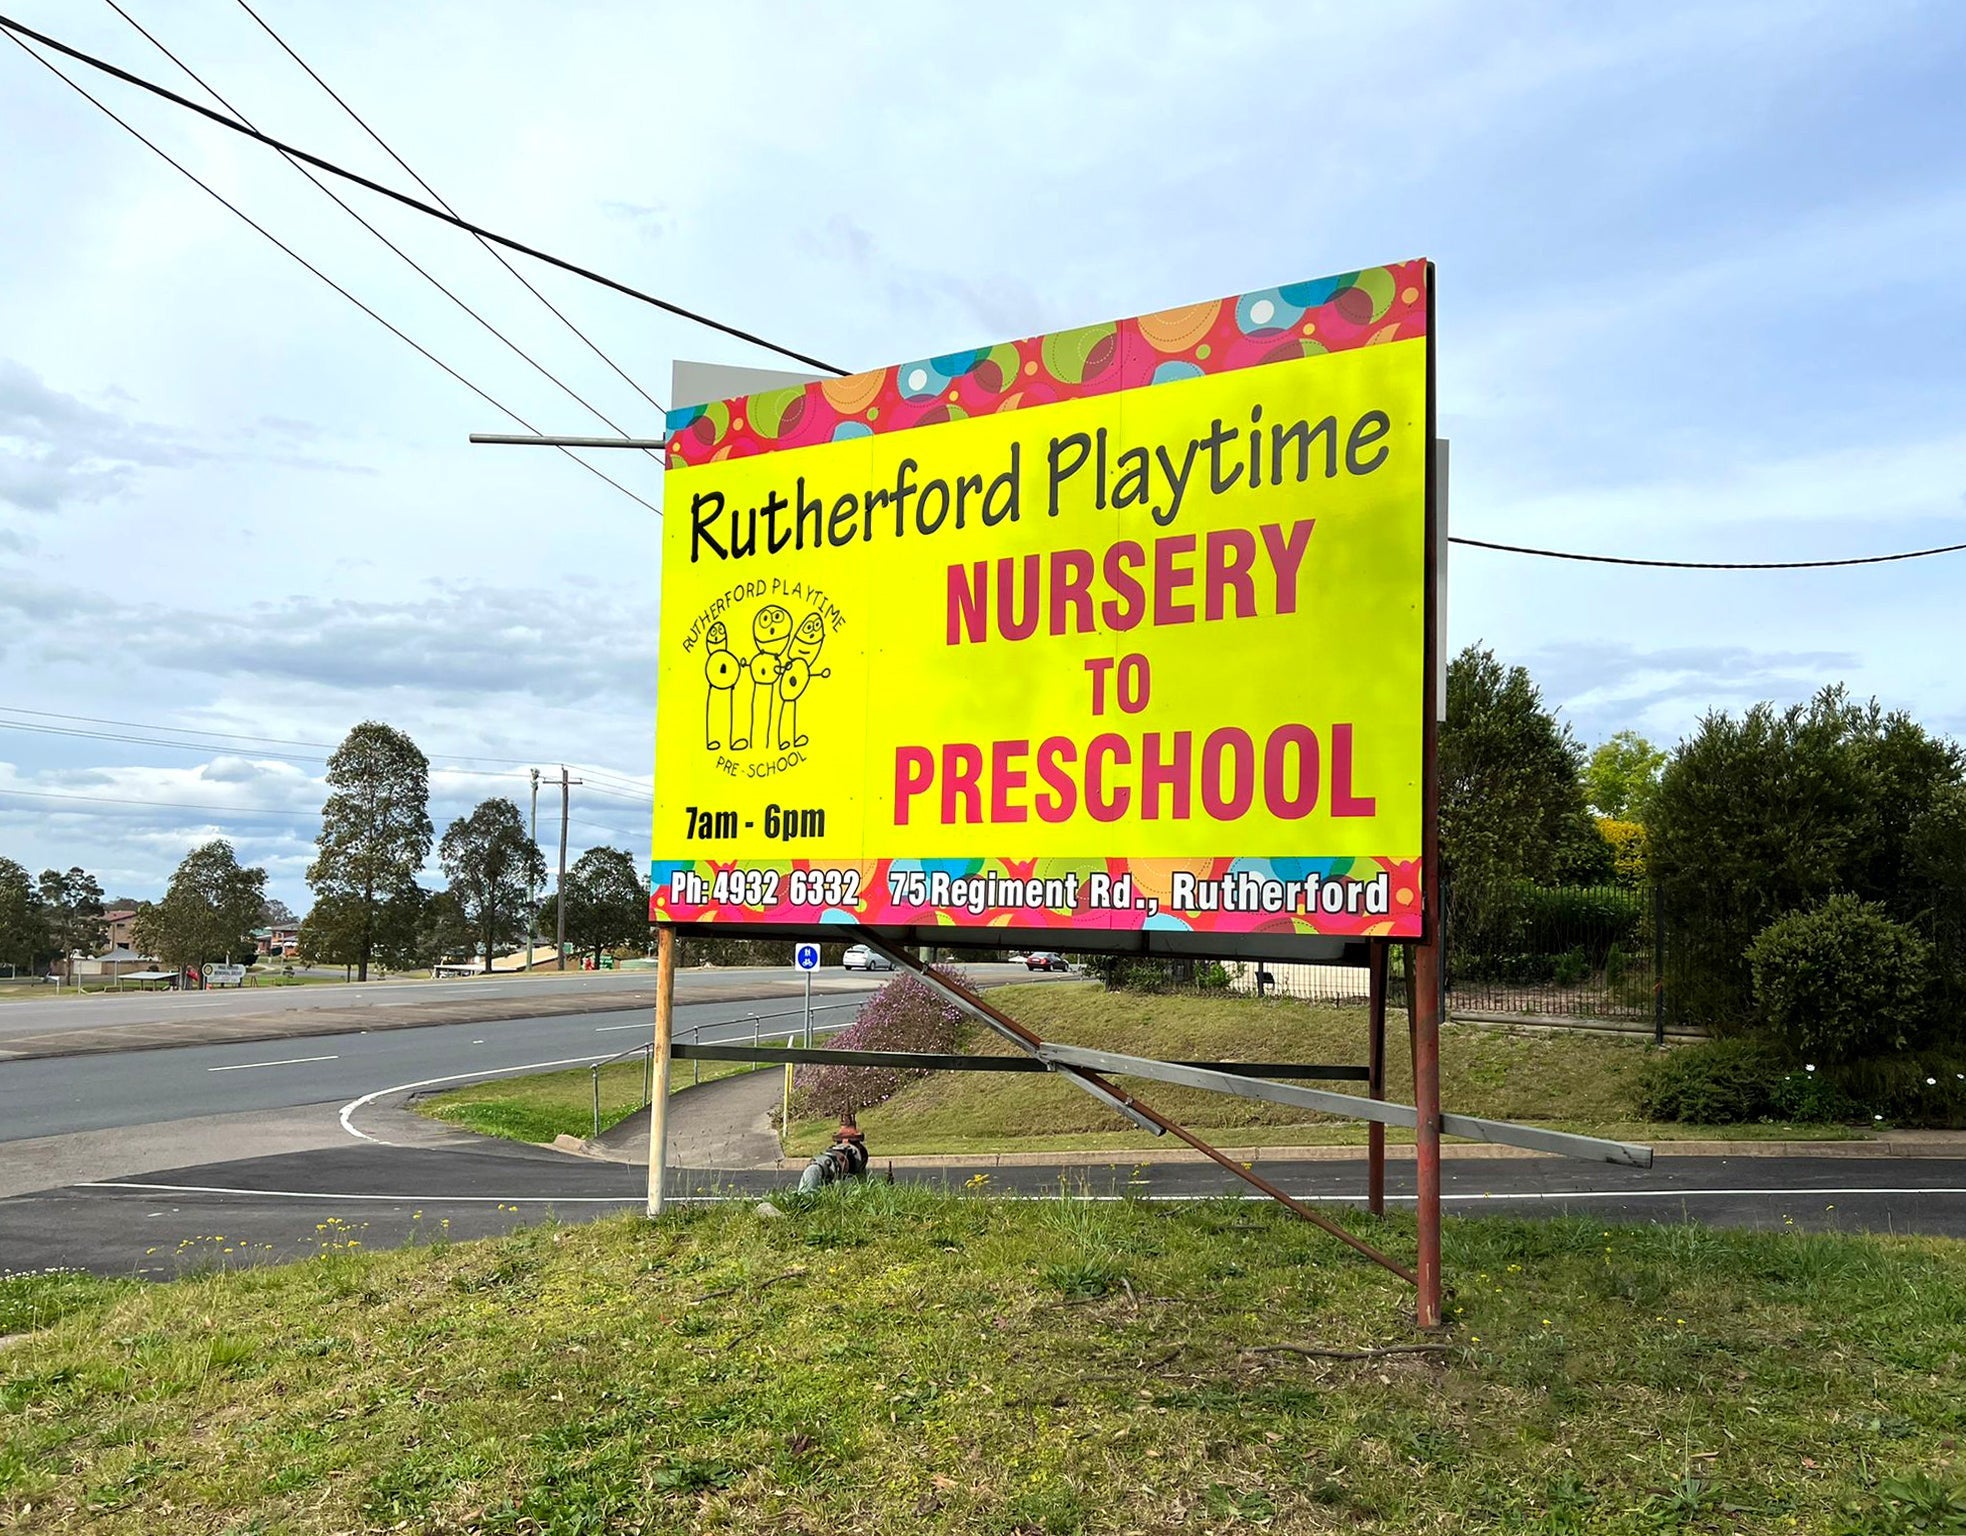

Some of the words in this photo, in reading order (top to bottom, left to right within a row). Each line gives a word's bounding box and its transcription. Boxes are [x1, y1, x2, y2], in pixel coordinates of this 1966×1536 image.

[691, 441, 1021, 563] Rutherford
[1047, 403, 1391, 527] Playtime
[682, 579, 767, 653] RUTHERFORD
[772, 577, 846, 632] PLAYTIME
[946, 518, 1316, 646] NURSERY
[1084, 653, 1151, 716] TO
[893, 723, 1376, 826] PRESCHOOL
[685, 806, 738, 840] 7am
[764, 803, 826, 842] 6pm
[712, 869, 779, 905] 4932
[789, 870, 860, 906] 6332
[930, 871, 1079, 915] Regiment
[1171, 871, 1389, 914] Rutherford
